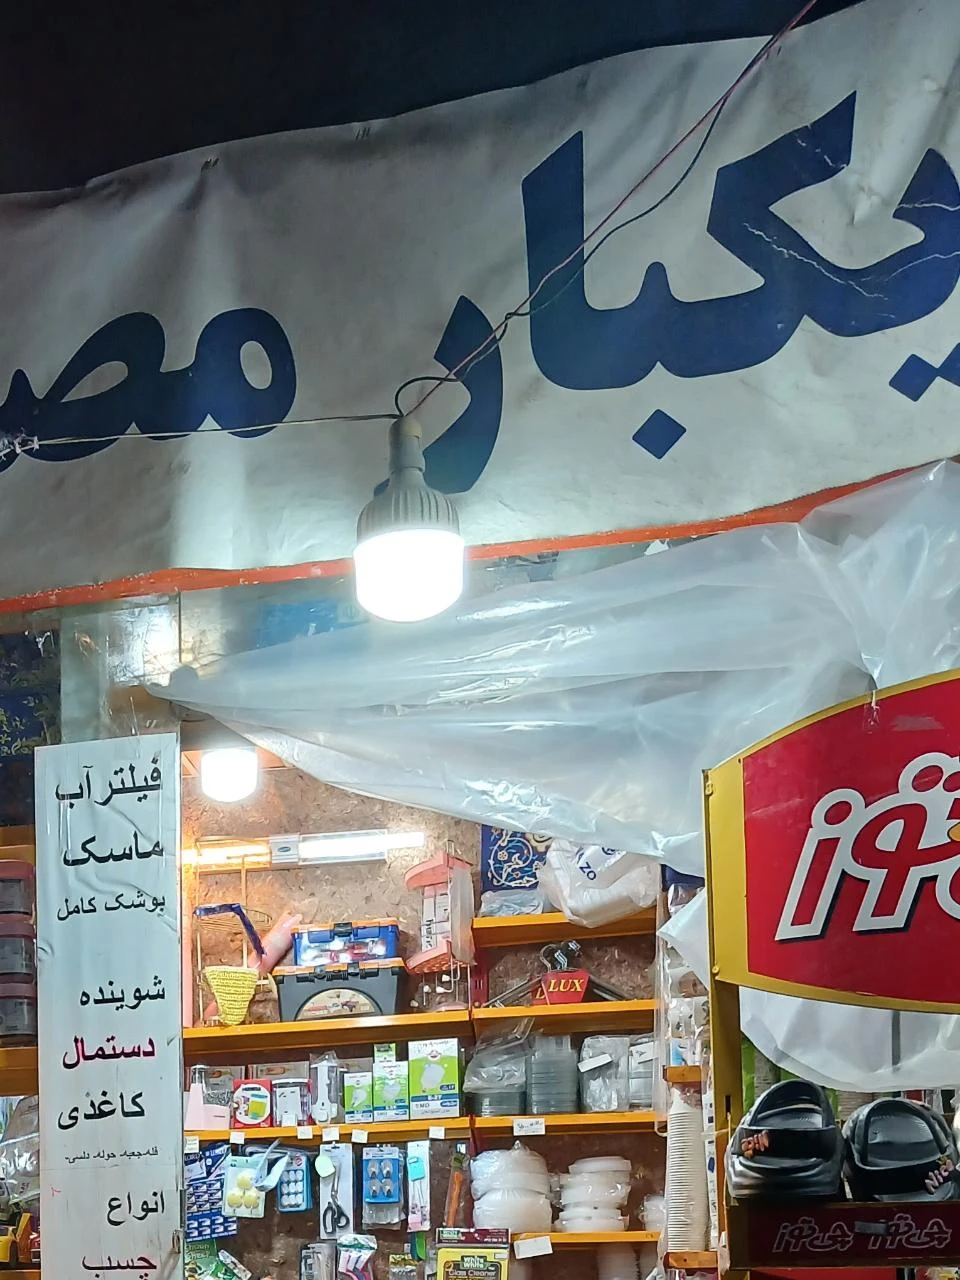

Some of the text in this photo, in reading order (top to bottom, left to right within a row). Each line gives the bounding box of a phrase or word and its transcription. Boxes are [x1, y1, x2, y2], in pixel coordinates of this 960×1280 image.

[55, 753, 163, 808] فیلتر آب
[63, 831, 164, 867] ماسک
[57, 890, 166, 921] پوشک کامل
[80, 975, 166, 1010] شوینده
[548, 979, 584, 992] LUX
[62, 1034, 156, 1069] دستمال
[58, 1089, 146, 1130] کاغذی
[106, 1190, 165, 1226] انواع
[468, 1269, 496, 1277] Cleaner
